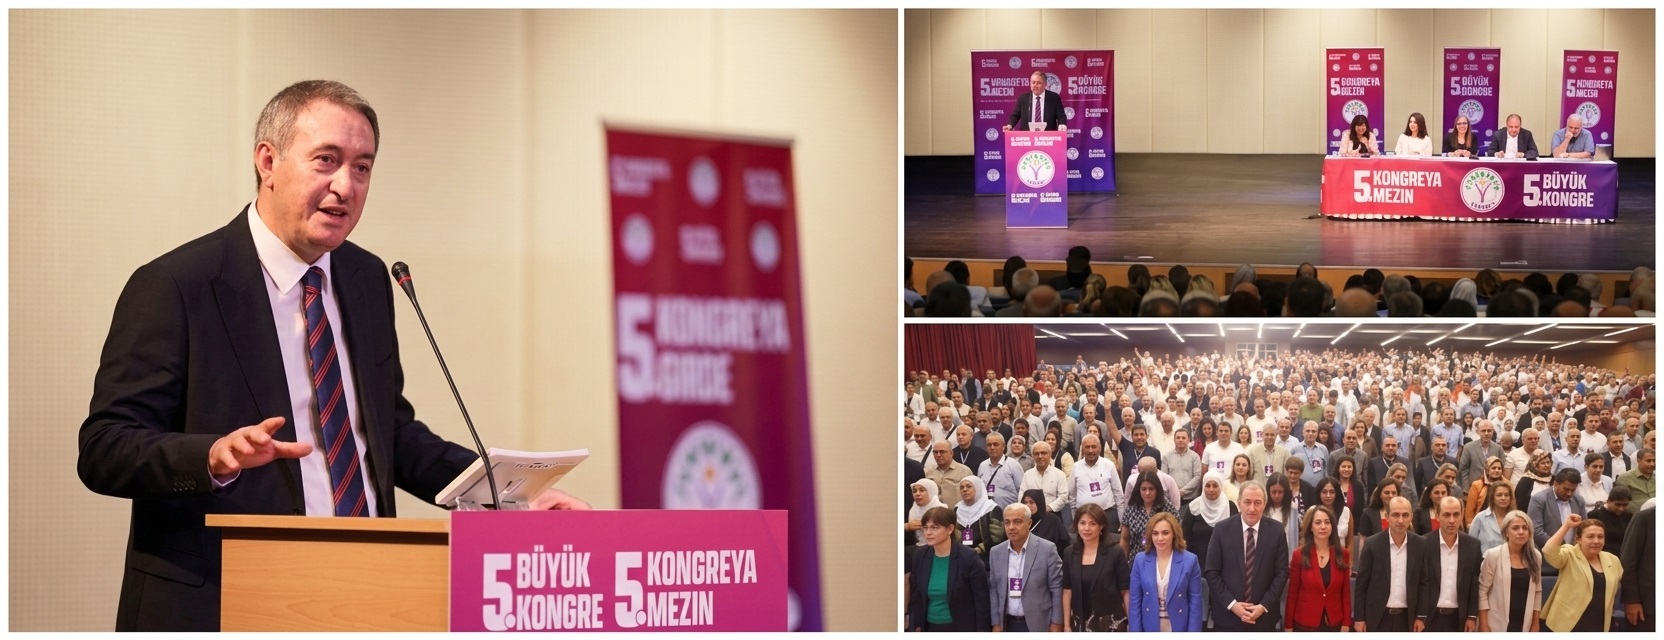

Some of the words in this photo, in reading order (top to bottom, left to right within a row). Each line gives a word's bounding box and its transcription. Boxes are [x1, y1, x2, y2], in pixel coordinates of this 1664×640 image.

[1373, 170, 1442, 188] KONGREYA
[1542, 171, 1587, 190] BÜYÜK
[1373, 188, 1414, 204] MEZIN
[1542, 191, 1595, 208] KONGRE
[516, 544, 591, 589] BÜYÜK
[647, 549, 758, 586] KONGREYA
[516, 593, 604, 631] KONGRE
[647, 590, 714, 627] MEZIN
